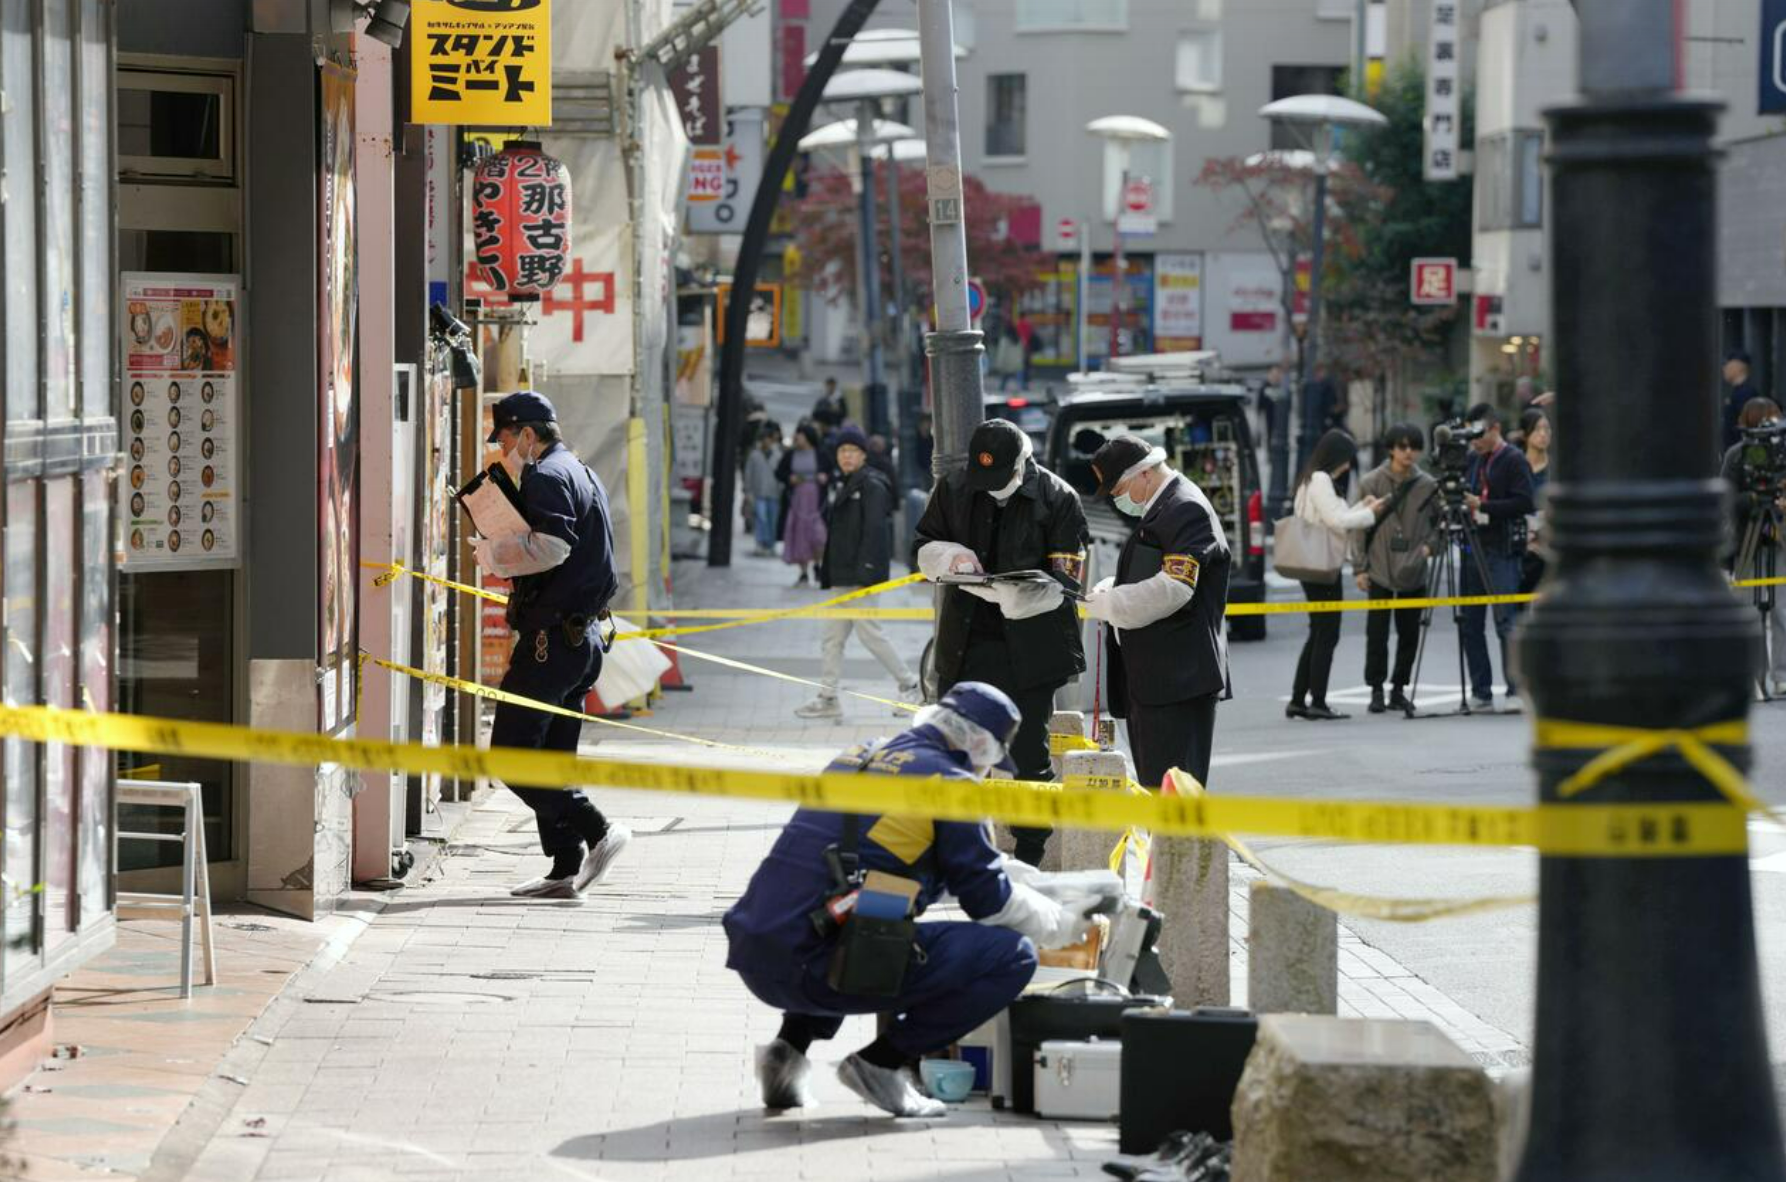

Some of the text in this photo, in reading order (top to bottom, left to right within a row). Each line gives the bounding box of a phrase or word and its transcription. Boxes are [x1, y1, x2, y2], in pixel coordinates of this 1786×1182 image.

[427, 33, 535, 58] スタンド
[428, 63, 535, 103] ミート
[465, 59, 499, 75] バイ
[937, 200, 956, 219] 14
[473, 182, 507, 291] やきとり
[516, 182, 566, 289] 那古野
[1420, 266, 1447, 298] 足
